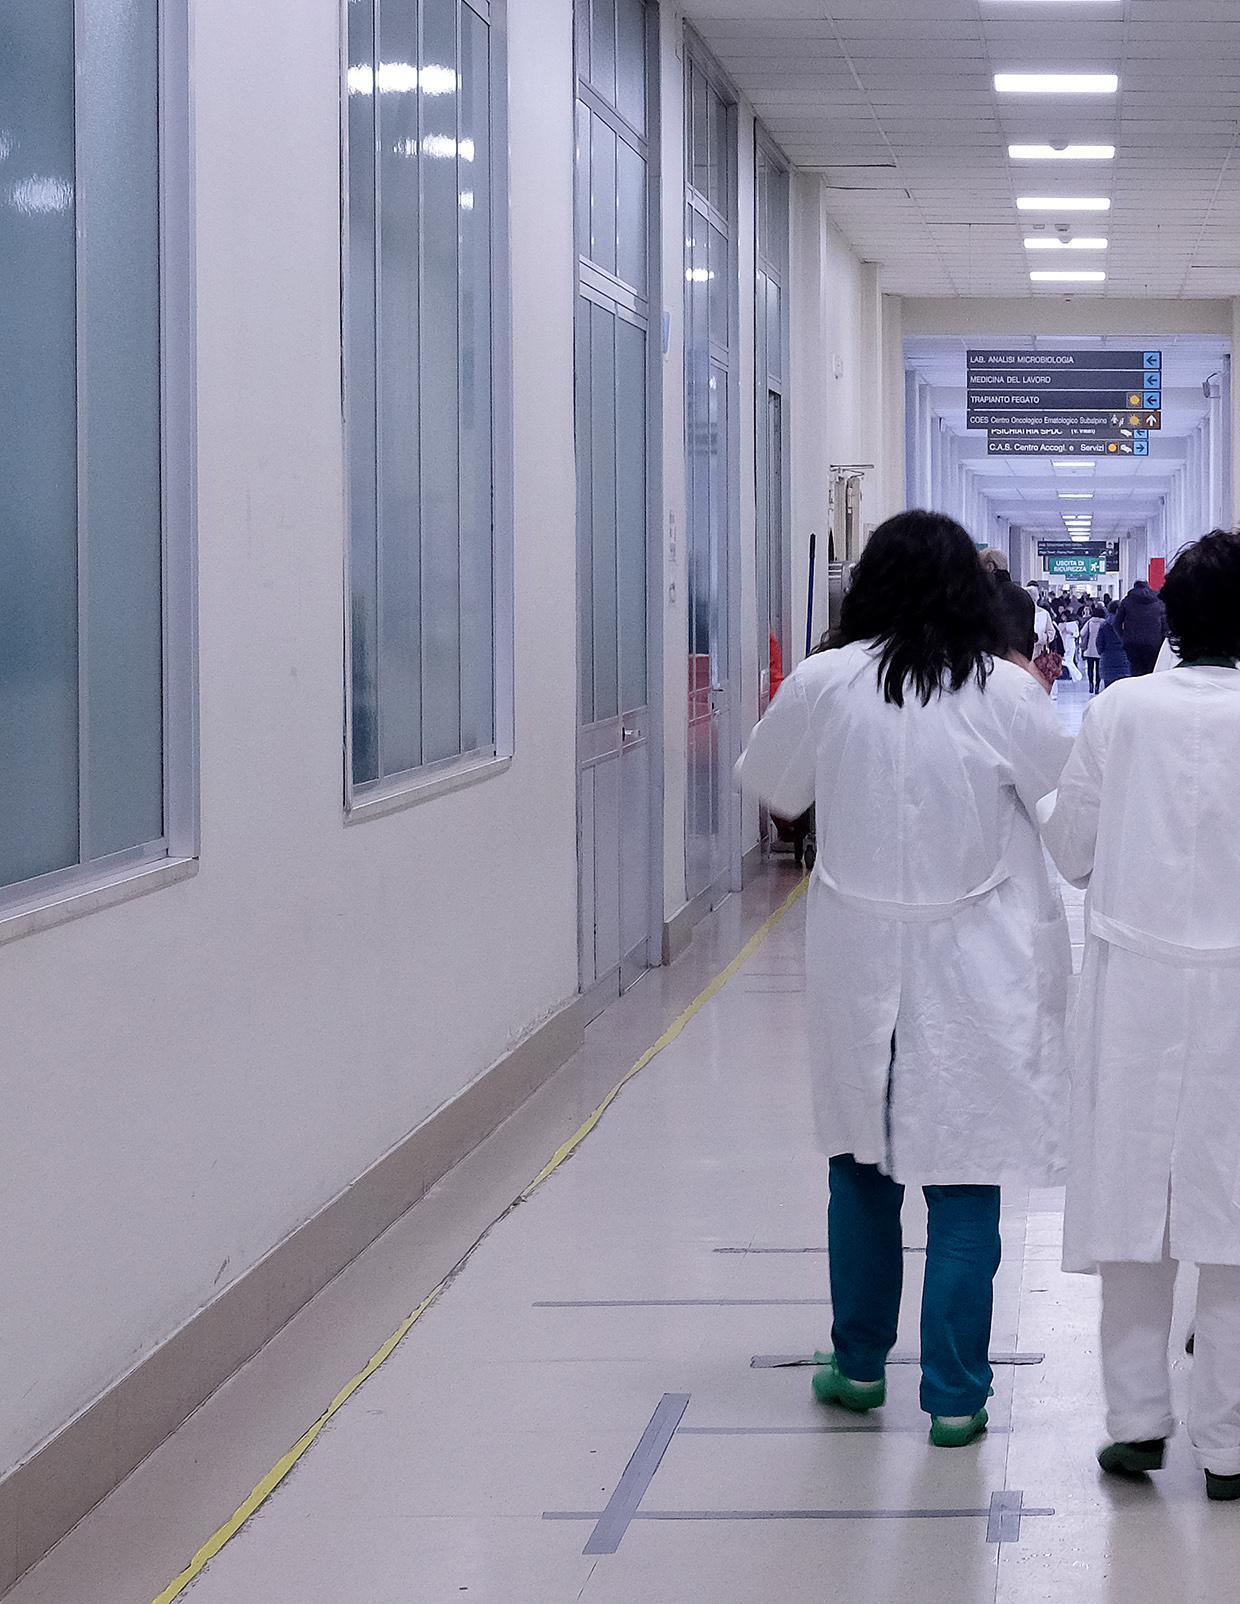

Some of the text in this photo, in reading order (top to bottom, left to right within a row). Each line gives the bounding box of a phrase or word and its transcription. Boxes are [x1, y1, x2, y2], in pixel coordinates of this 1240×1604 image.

[988, 356, 1015, 364] ANALISI
[1017, 356, 1075, 364] MICROBIOLOGIA
[970, 376, 1051, 384] MEDICINA DEL LAVORO
[971, 396, 1040, 404] TRAPIANTO FEGATO
[970, 416, 1108, 426] COES Centro Oncologico Ematologico Subalpino
[989, 443, 1012, 451] C.A.S.
[1014, 443, 1039, 452] Centro
[1040, 443, 1067, 453] Accogl.
[1080, 443, 1105, 452] Servizi
